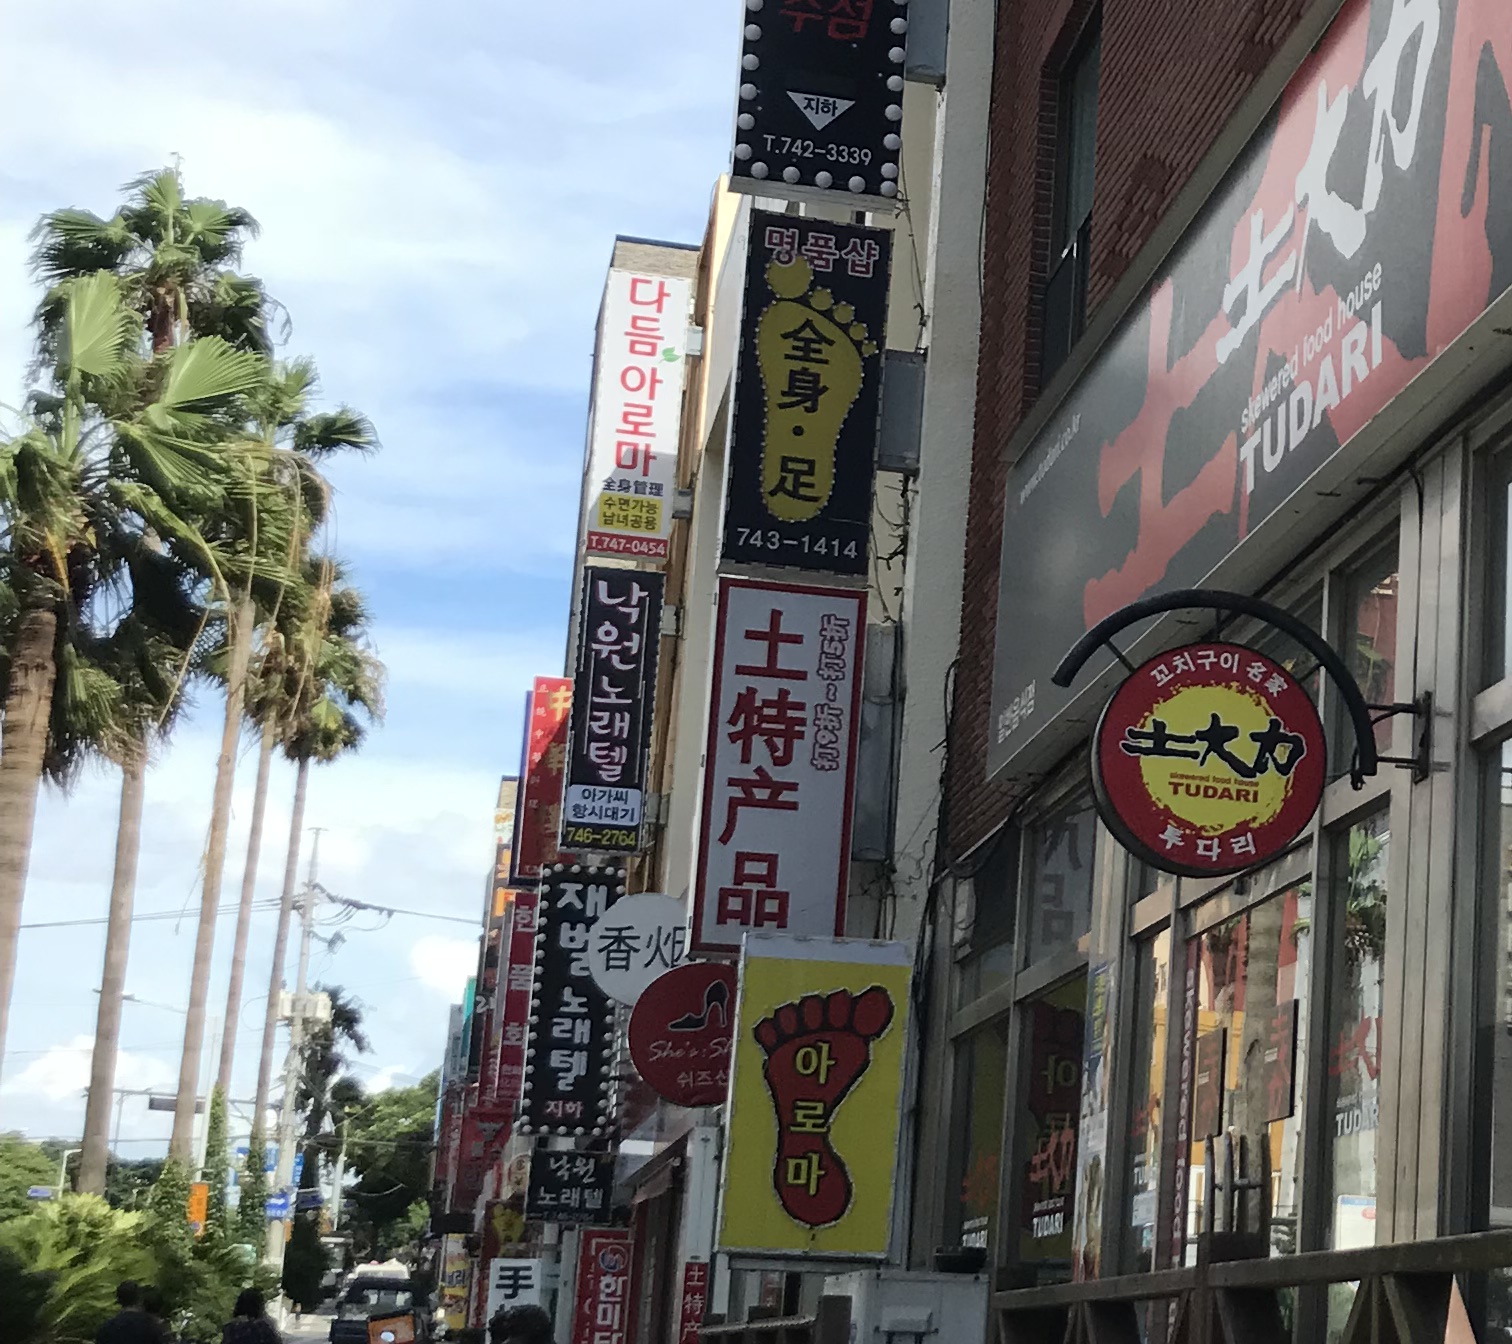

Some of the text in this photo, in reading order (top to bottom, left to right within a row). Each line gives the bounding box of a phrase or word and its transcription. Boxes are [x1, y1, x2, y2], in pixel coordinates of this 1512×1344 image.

[803, 96, 839, 120] 지하
[762, 133, 872, 167] T.742-3339
[765, 225, 879, 278] 명품샵
[1241, 262, 1383, 434] skewered food house
[1240, 299, 1383, 496] TUDARI
[602, 477, 664, 497] 全身管理
[591, 536, 666, 556] T.747-0454
[736, 527, 858, 559] 743-1414
[1150, 650, 1240, 688] 꼬치구이
[716, 608, 809, 929] 土特产品
[581, 787, 629, 805] 아가씨
[1168, 780, 1260, 804] TUDARI
[566, 826, 637, 846] 746-2764
[545, 1100, 584, 1119] 지하
[786, 1040, 836, 1197] 아로마
